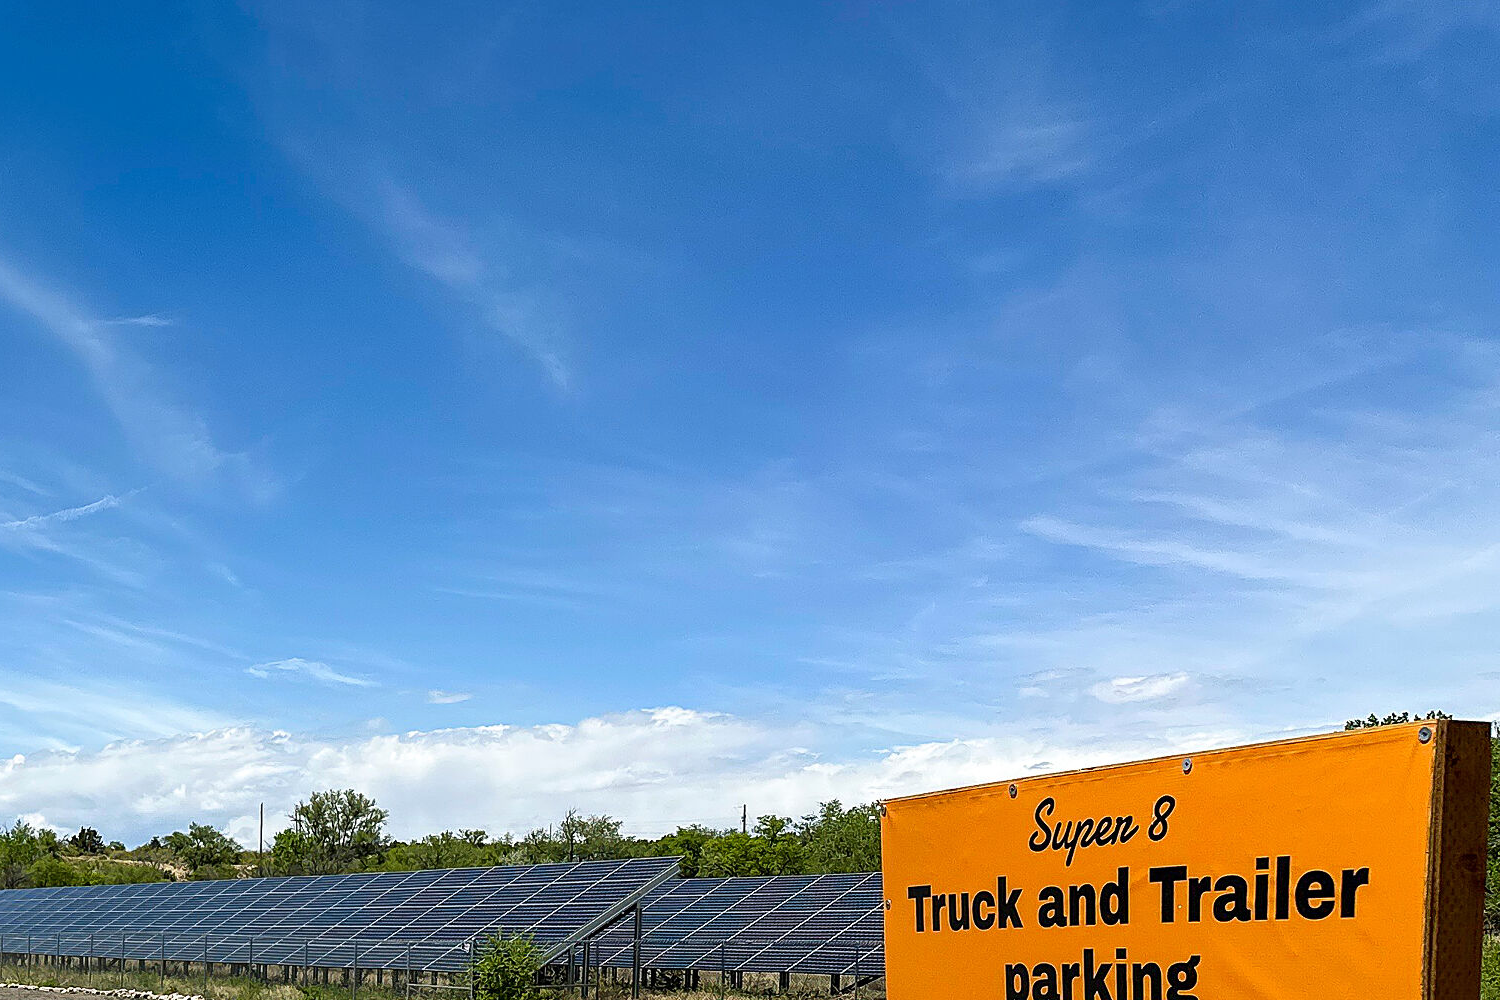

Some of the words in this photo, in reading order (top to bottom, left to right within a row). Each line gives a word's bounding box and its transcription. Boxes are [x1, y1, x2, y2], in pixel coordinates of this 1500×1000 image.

[1029, 797, 1139, 867] Super
[1148, 795, 1176, 842] 8
[907, 876, 1024, 933] Truck
[1038, 866, 1130, 929] and
[1149, 855, 1371, 923] Trailer
